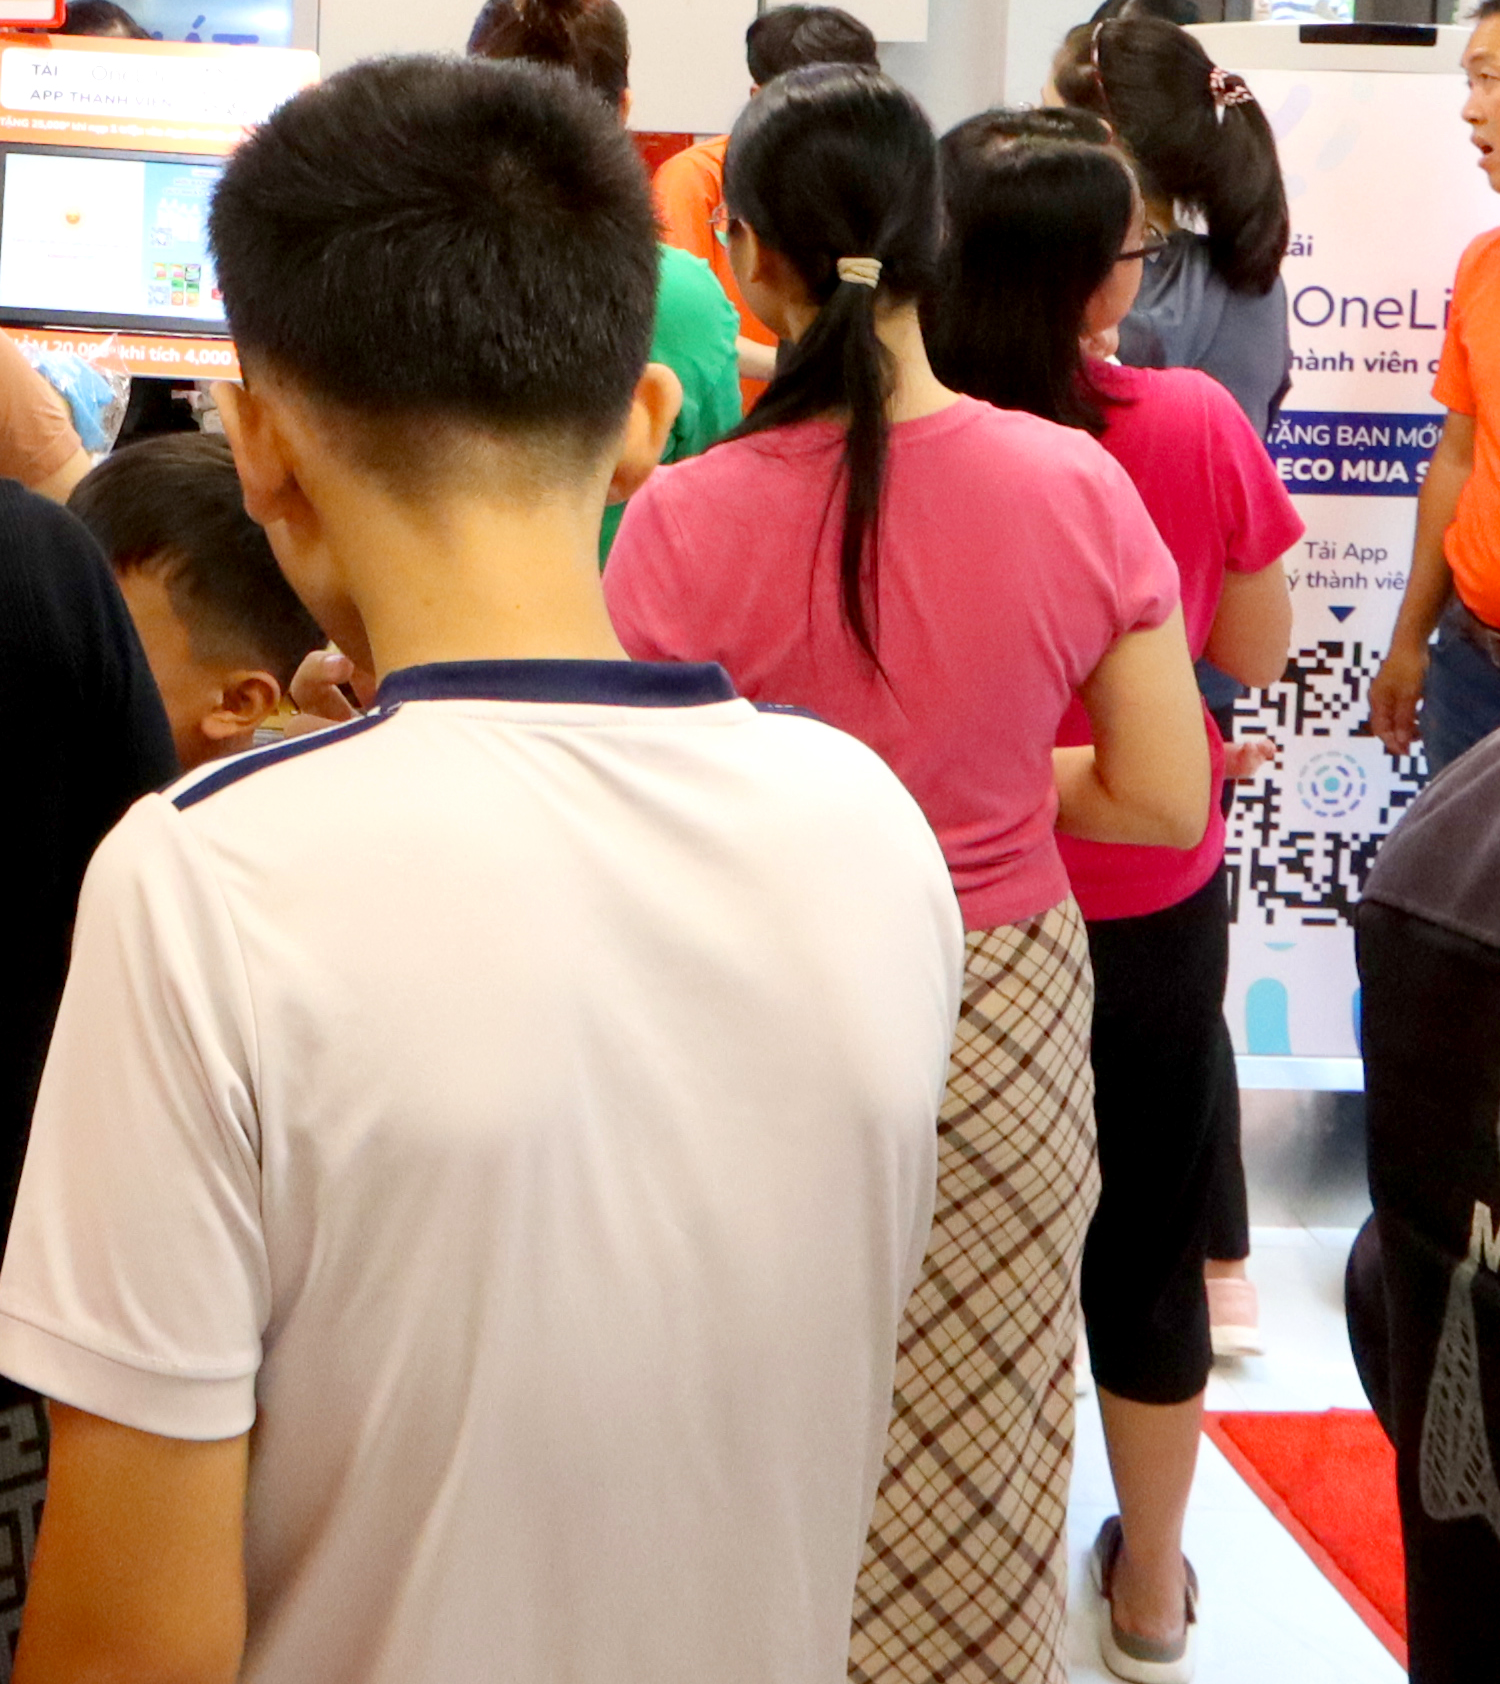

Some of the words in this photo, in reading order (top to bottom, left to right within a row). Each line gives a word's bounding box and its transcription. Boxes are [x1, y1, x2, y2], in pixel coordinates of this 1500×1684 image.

[30, 89, 63, 102] APP
[119, 338, 145, 361] khi
[148, 340, 181, 363] tích
[183, 347, 232, 366] 4,000
[1363, 349, 1418, 374] viên
[1336, 424, 1391, 452] BẠN
[1279, 457, 1336, 481] ECO
[1341, 459, 1409, 484] MUA
[1304, 540, 1337, 560] Tải
[1342, 542, 1388, 564] App
[1305, 568, 1368, 590] thành
[1375, 569, 1409, 591] viê
